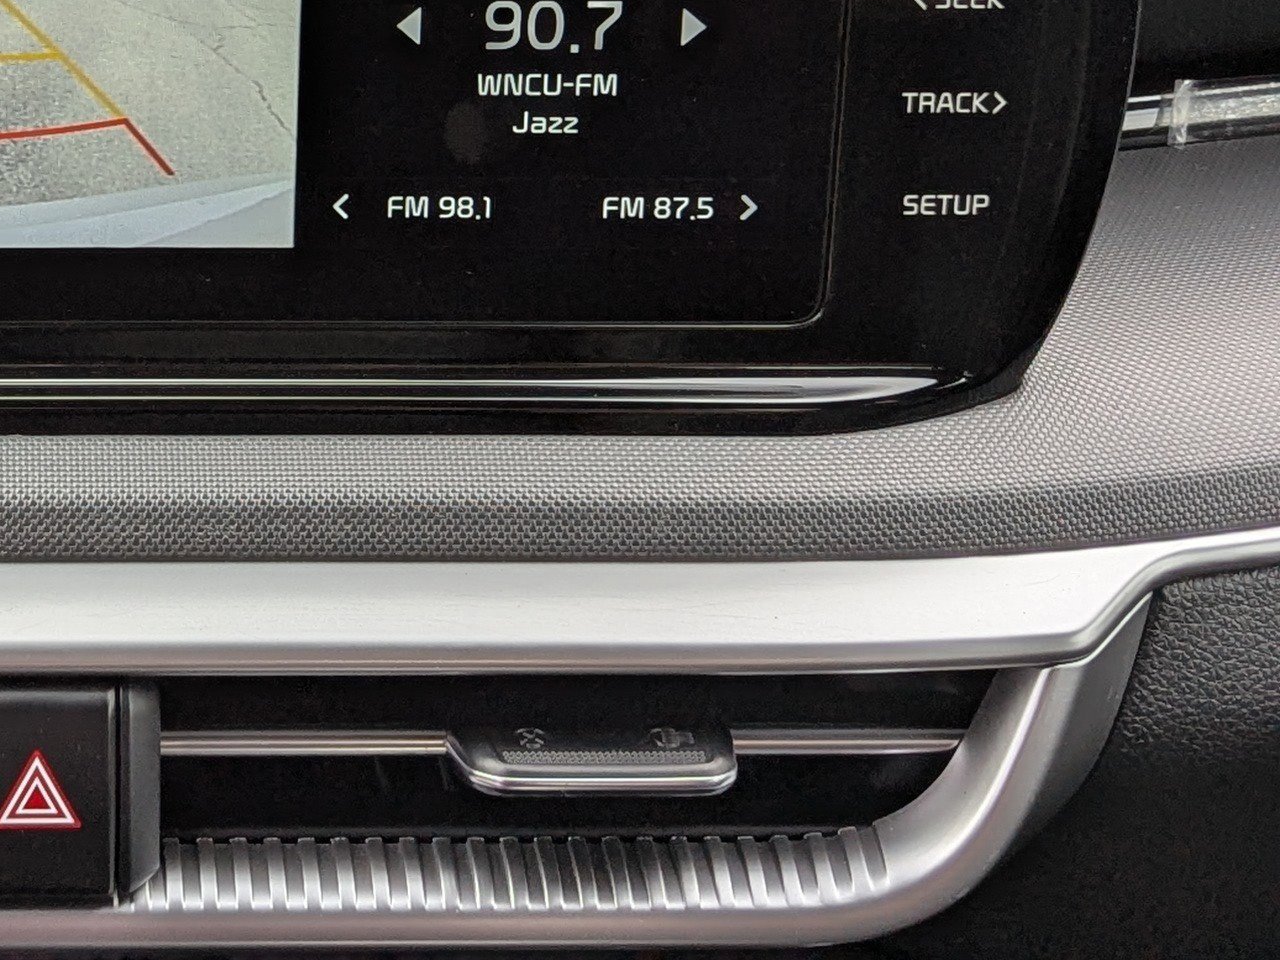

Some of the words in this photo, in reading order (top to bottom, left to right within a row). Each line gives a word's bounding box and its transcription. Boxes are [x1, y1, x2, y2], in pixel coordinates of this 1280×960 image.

[484, 0, 624, 55] 90.7
[476, 73, 619, 98] WNCU-FM
[511, 110, 580, 135] Jazz
[386, 195, 429, 220] FM
[437, 195, 493, 221] 98.1
[601, 195, 645, 220] FM
[652, 195, 715, 222] 87.5
[901, 193, 991, 217] SETUP
